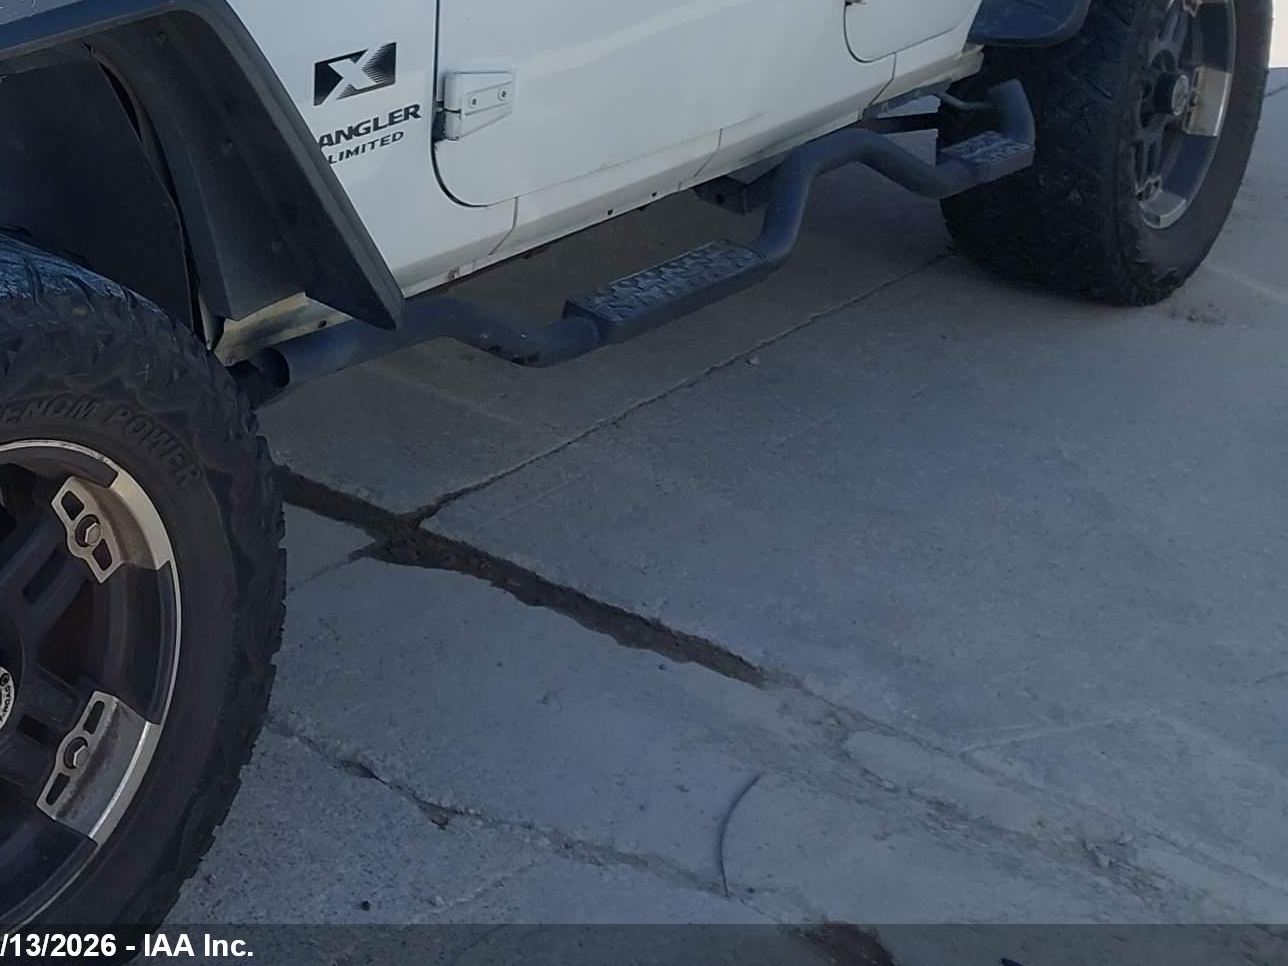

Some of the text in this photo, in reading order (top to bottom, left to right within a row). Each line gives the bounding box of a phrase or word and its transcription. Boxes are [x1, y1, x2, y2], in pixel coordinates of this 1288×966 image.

[318, 103, 423, 147] ANGLER
[327, 130, 405, 165] LIMITED
[102, 407, 204, 484] POWER
